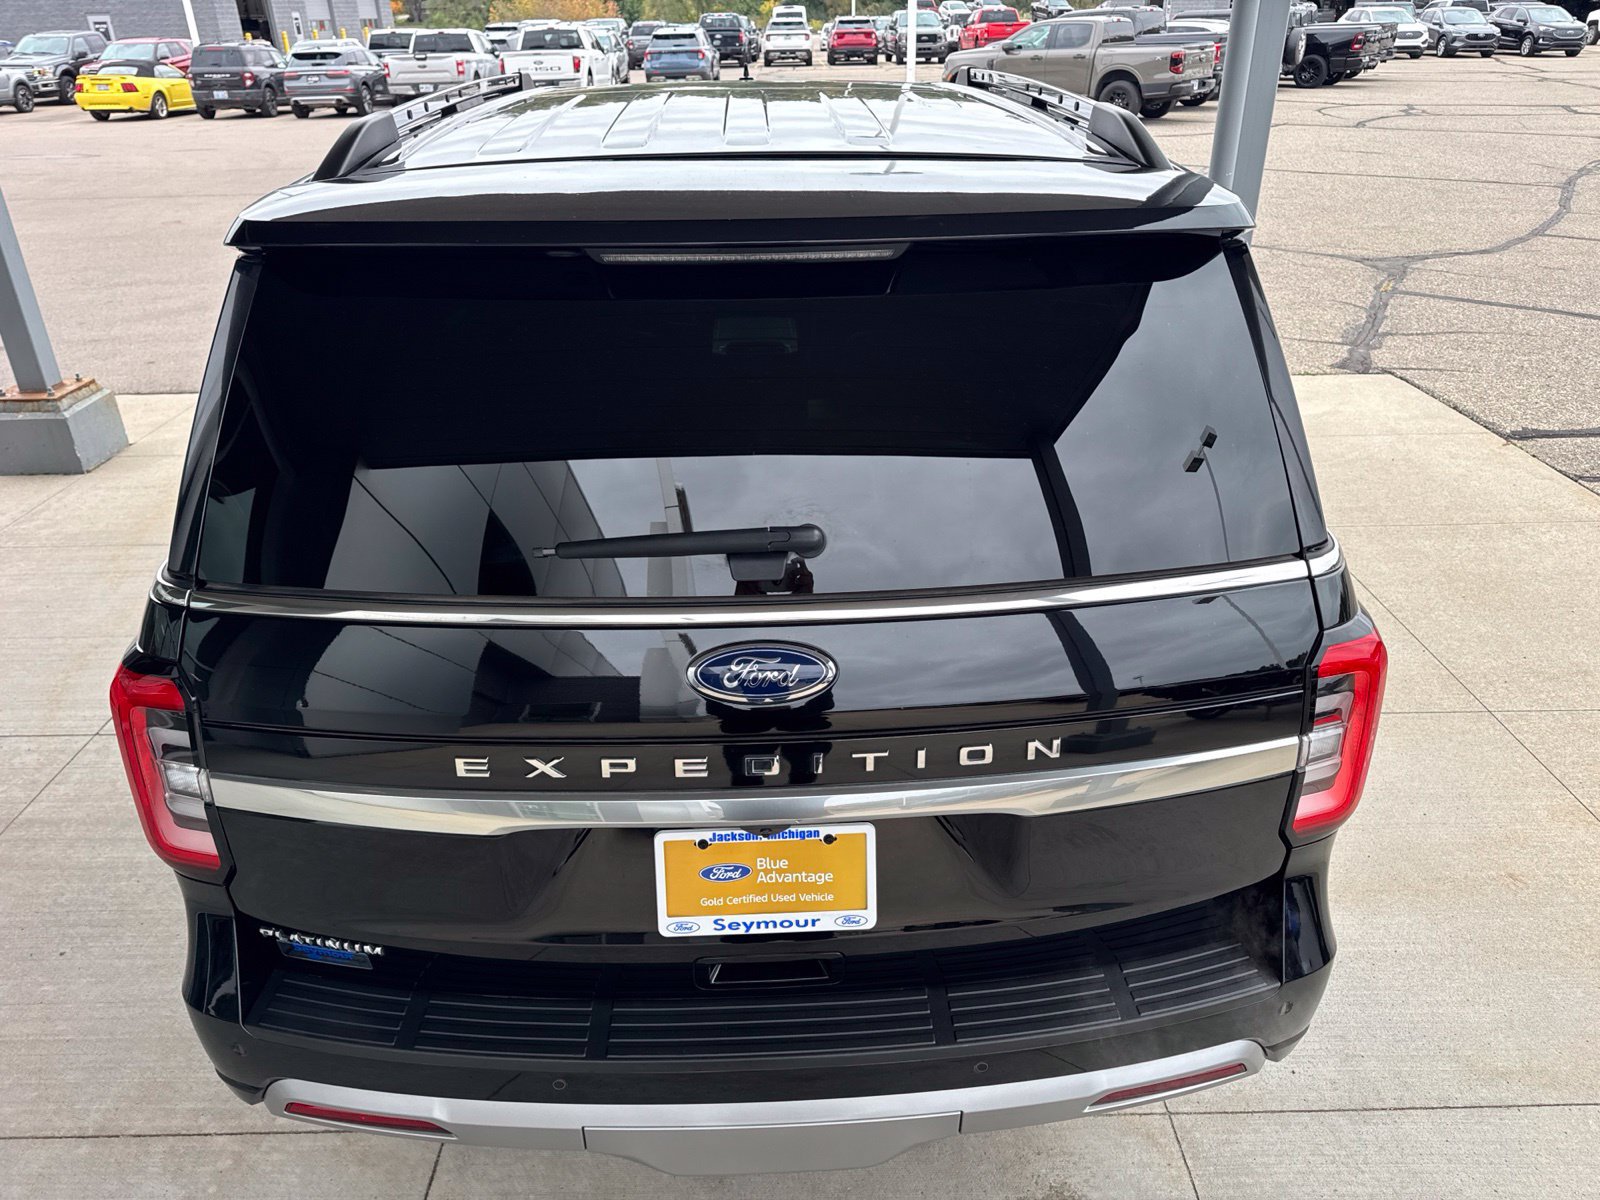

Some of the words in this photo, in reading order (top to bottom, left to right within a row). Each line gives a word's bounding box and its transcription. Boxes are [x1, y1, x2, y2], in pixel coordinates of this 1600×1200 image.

[723, 656, 801, 689] Ford
[454, 737, 1062, 779] EXPEDITION
[756, 857, 789, 870] Blue
[709, 866, 742, 880] Ford
[756, 871, 834, 885] Advantage
[700, 897, 724, 907] Gold
[726, 893, 769, 905] Certified
[771, 892, 796, 903] Used
[799, 892, 834, 902] Vehicle
[673, 922, 694, 932] Ford
[713, 918, 821, 933] Seymour
[841, 915, 862, 925] Ford
[259, 928, 384, 956] PLATINUM
